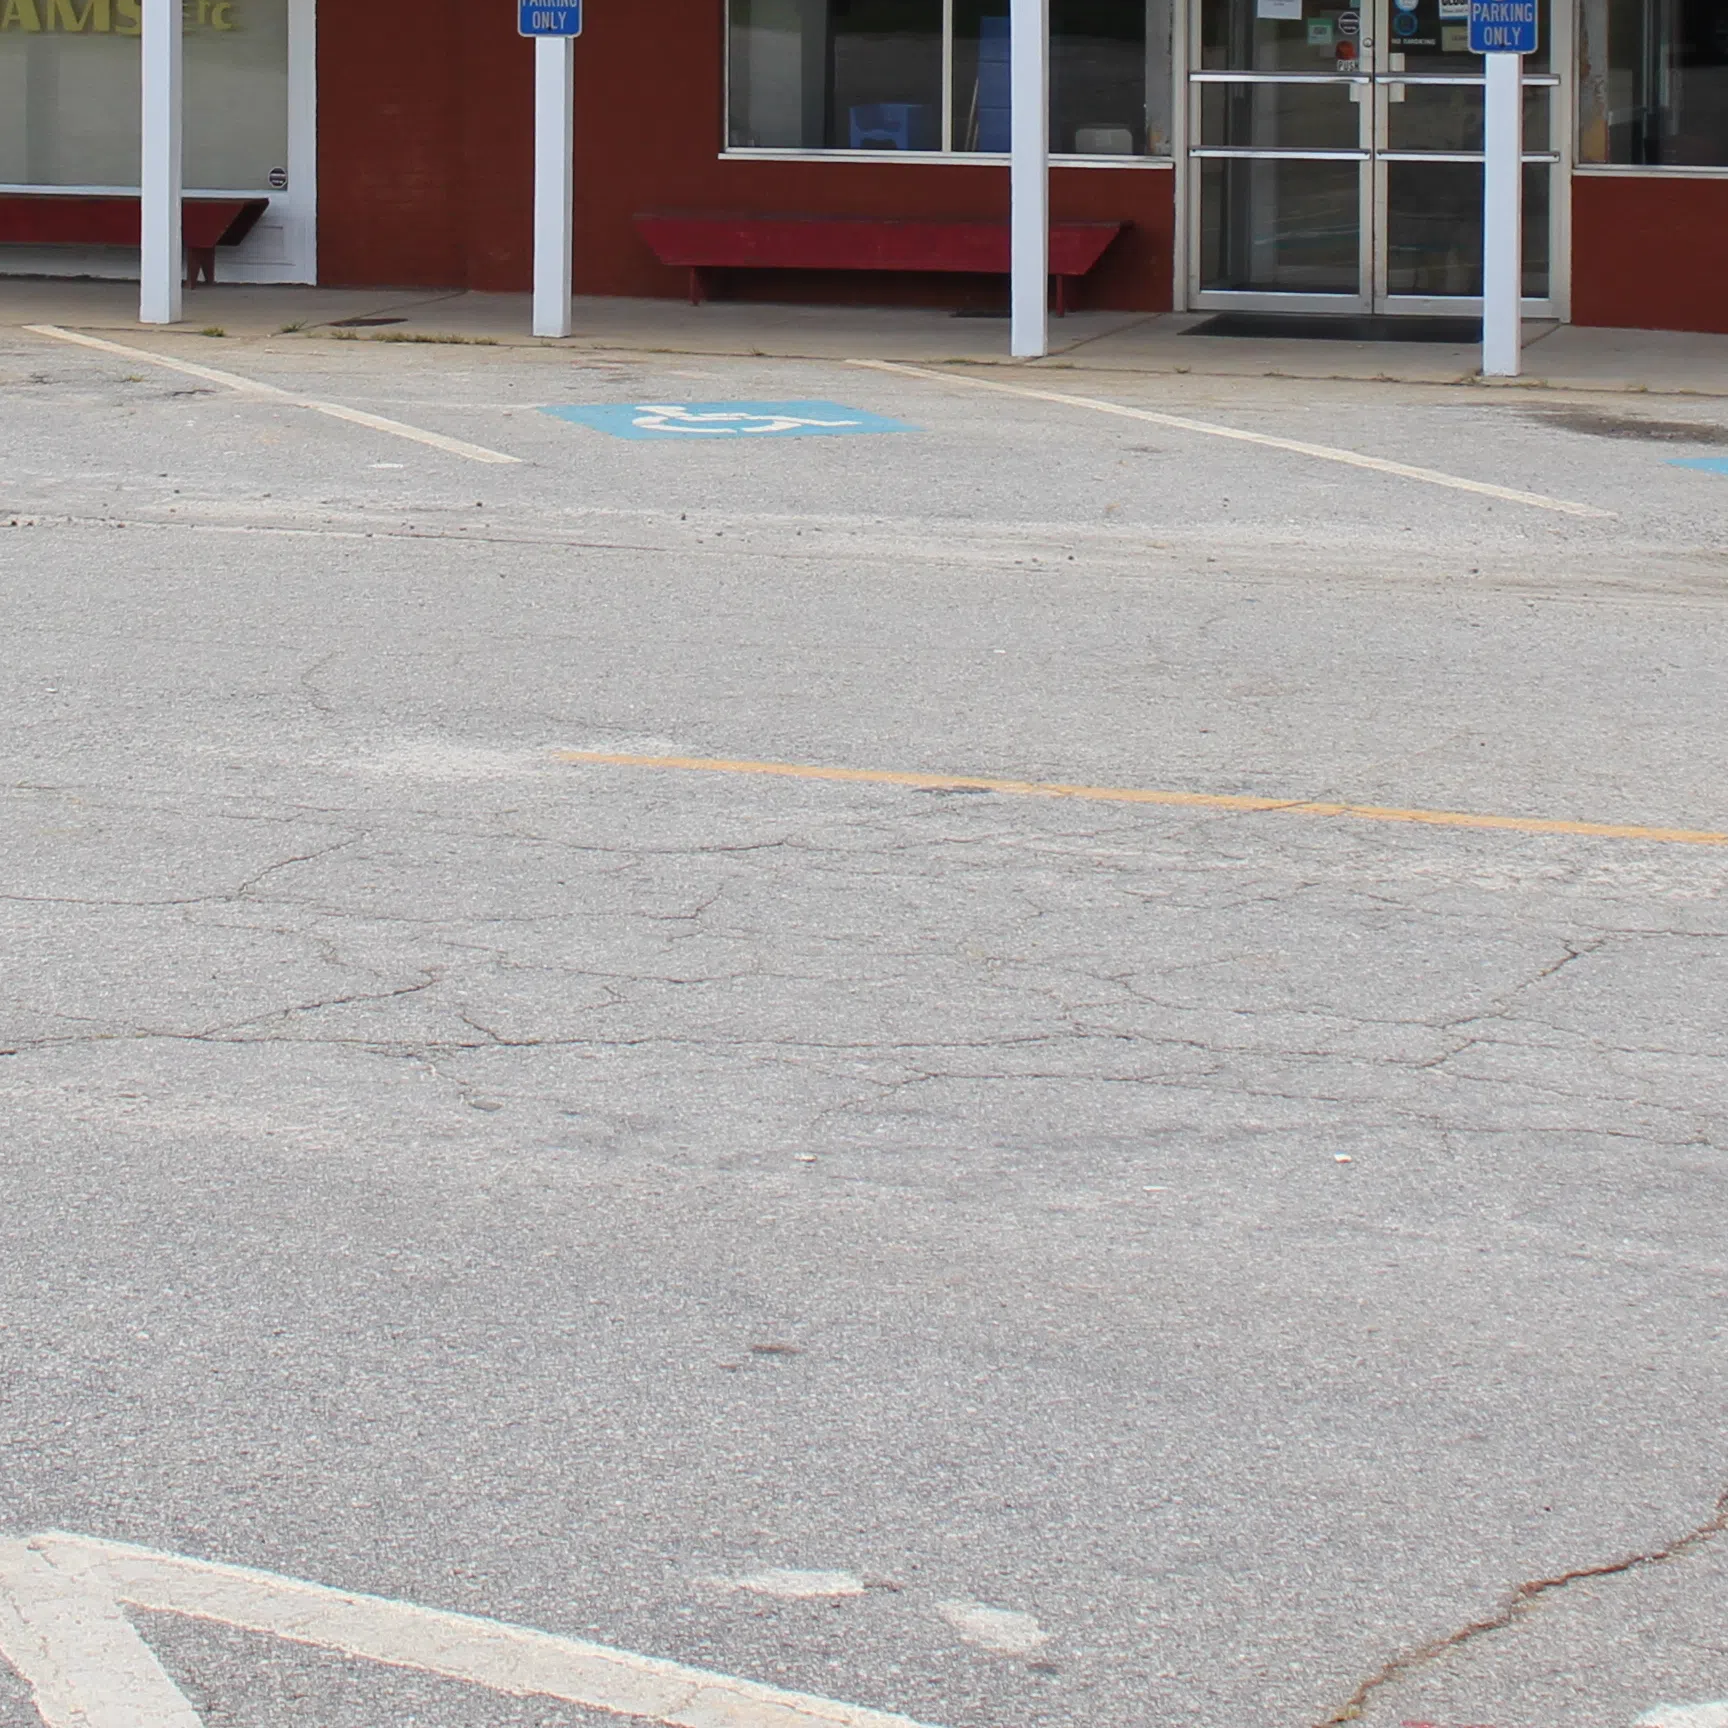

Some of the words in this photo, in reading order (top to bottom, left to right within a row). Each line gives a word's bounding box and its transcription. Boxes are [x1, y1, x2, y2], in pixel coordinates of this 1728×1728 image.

[532, 11, 567, 30] ONLY
[1472, 3, 1533, 22] PARKING
[1483, 26, 1522, 46] ONLY
